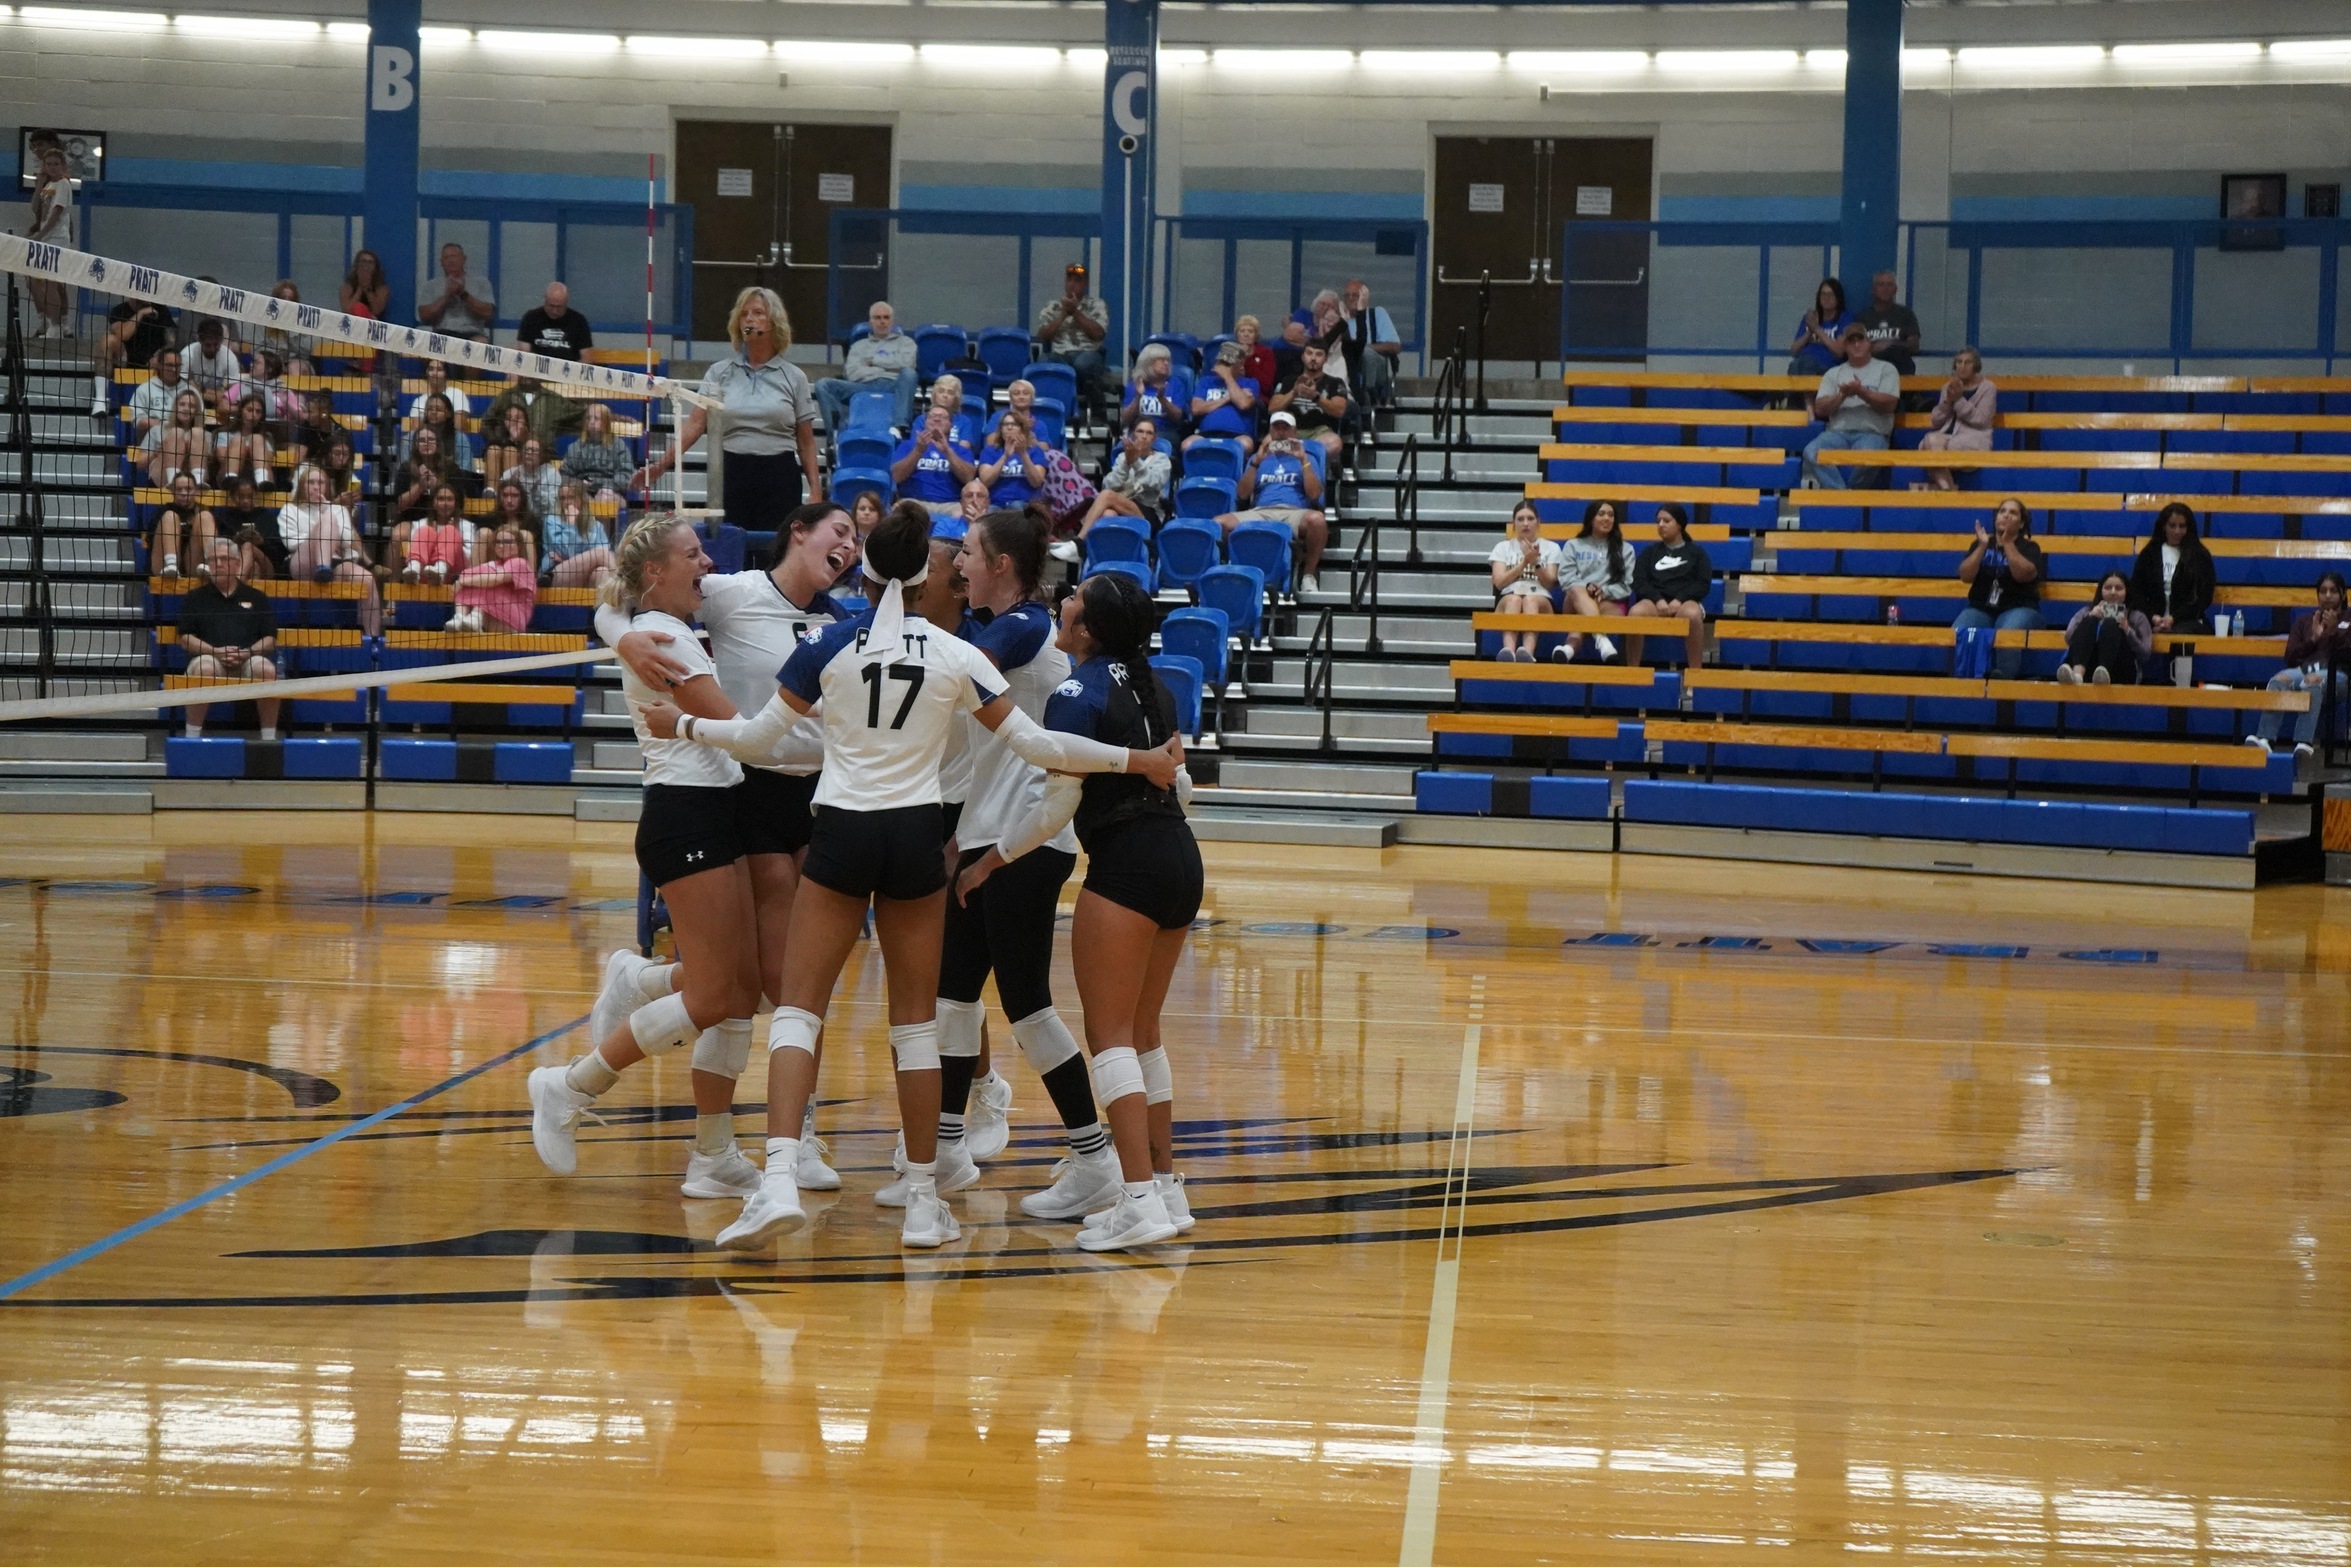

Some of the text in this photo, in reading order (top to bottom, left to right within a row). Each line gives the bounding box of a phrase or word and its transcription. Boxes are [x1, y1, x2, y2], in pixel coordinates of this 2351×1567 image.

[371, 45, 414, 111] B
[1112, 70, 1148, 135] C
[26, 241, 61, 273] PRATT
[129, 265, 160, 295] PRATT
[219, 286, 246, 313] PRATT
[297, 304, 321, 330] PRATT
[366, 320, 388, 344] PRATT
[855, 626, 928, 659] PTT
[861, 661, 925, 730] 17
